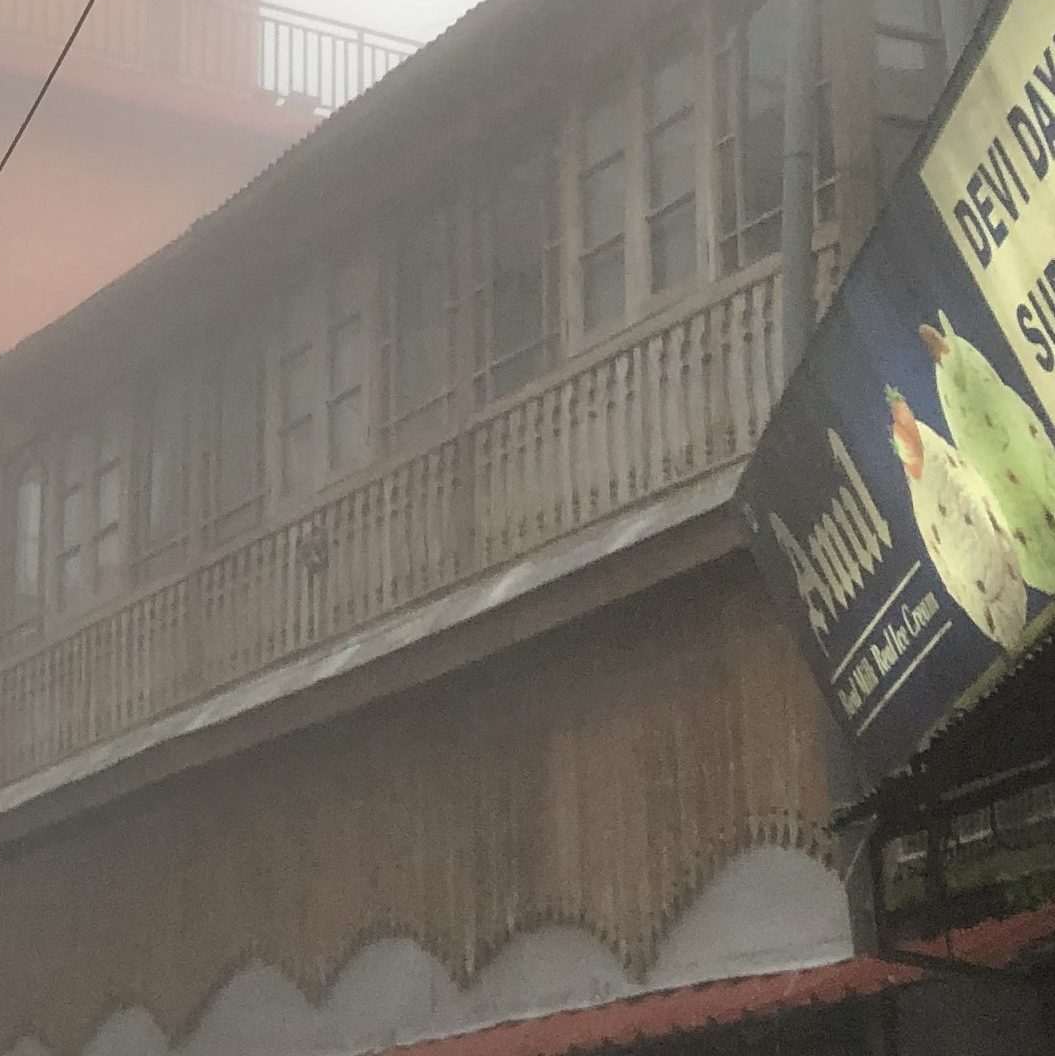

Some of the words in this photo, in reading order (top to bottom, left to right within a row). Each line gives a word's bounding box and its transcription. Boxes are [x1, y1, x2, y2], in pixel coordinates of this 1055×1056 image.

[953, 135, 1030, 270] DEVI
[1006, 32, 1055, 181] DAY
[1016, 259, 1055, 372] SU
[770, 427, 892, 657] Amul
[869, 628, 899, 676] Real
[888, 624, 910, 655] Ice
[901, 591, 940, 637] Cream
